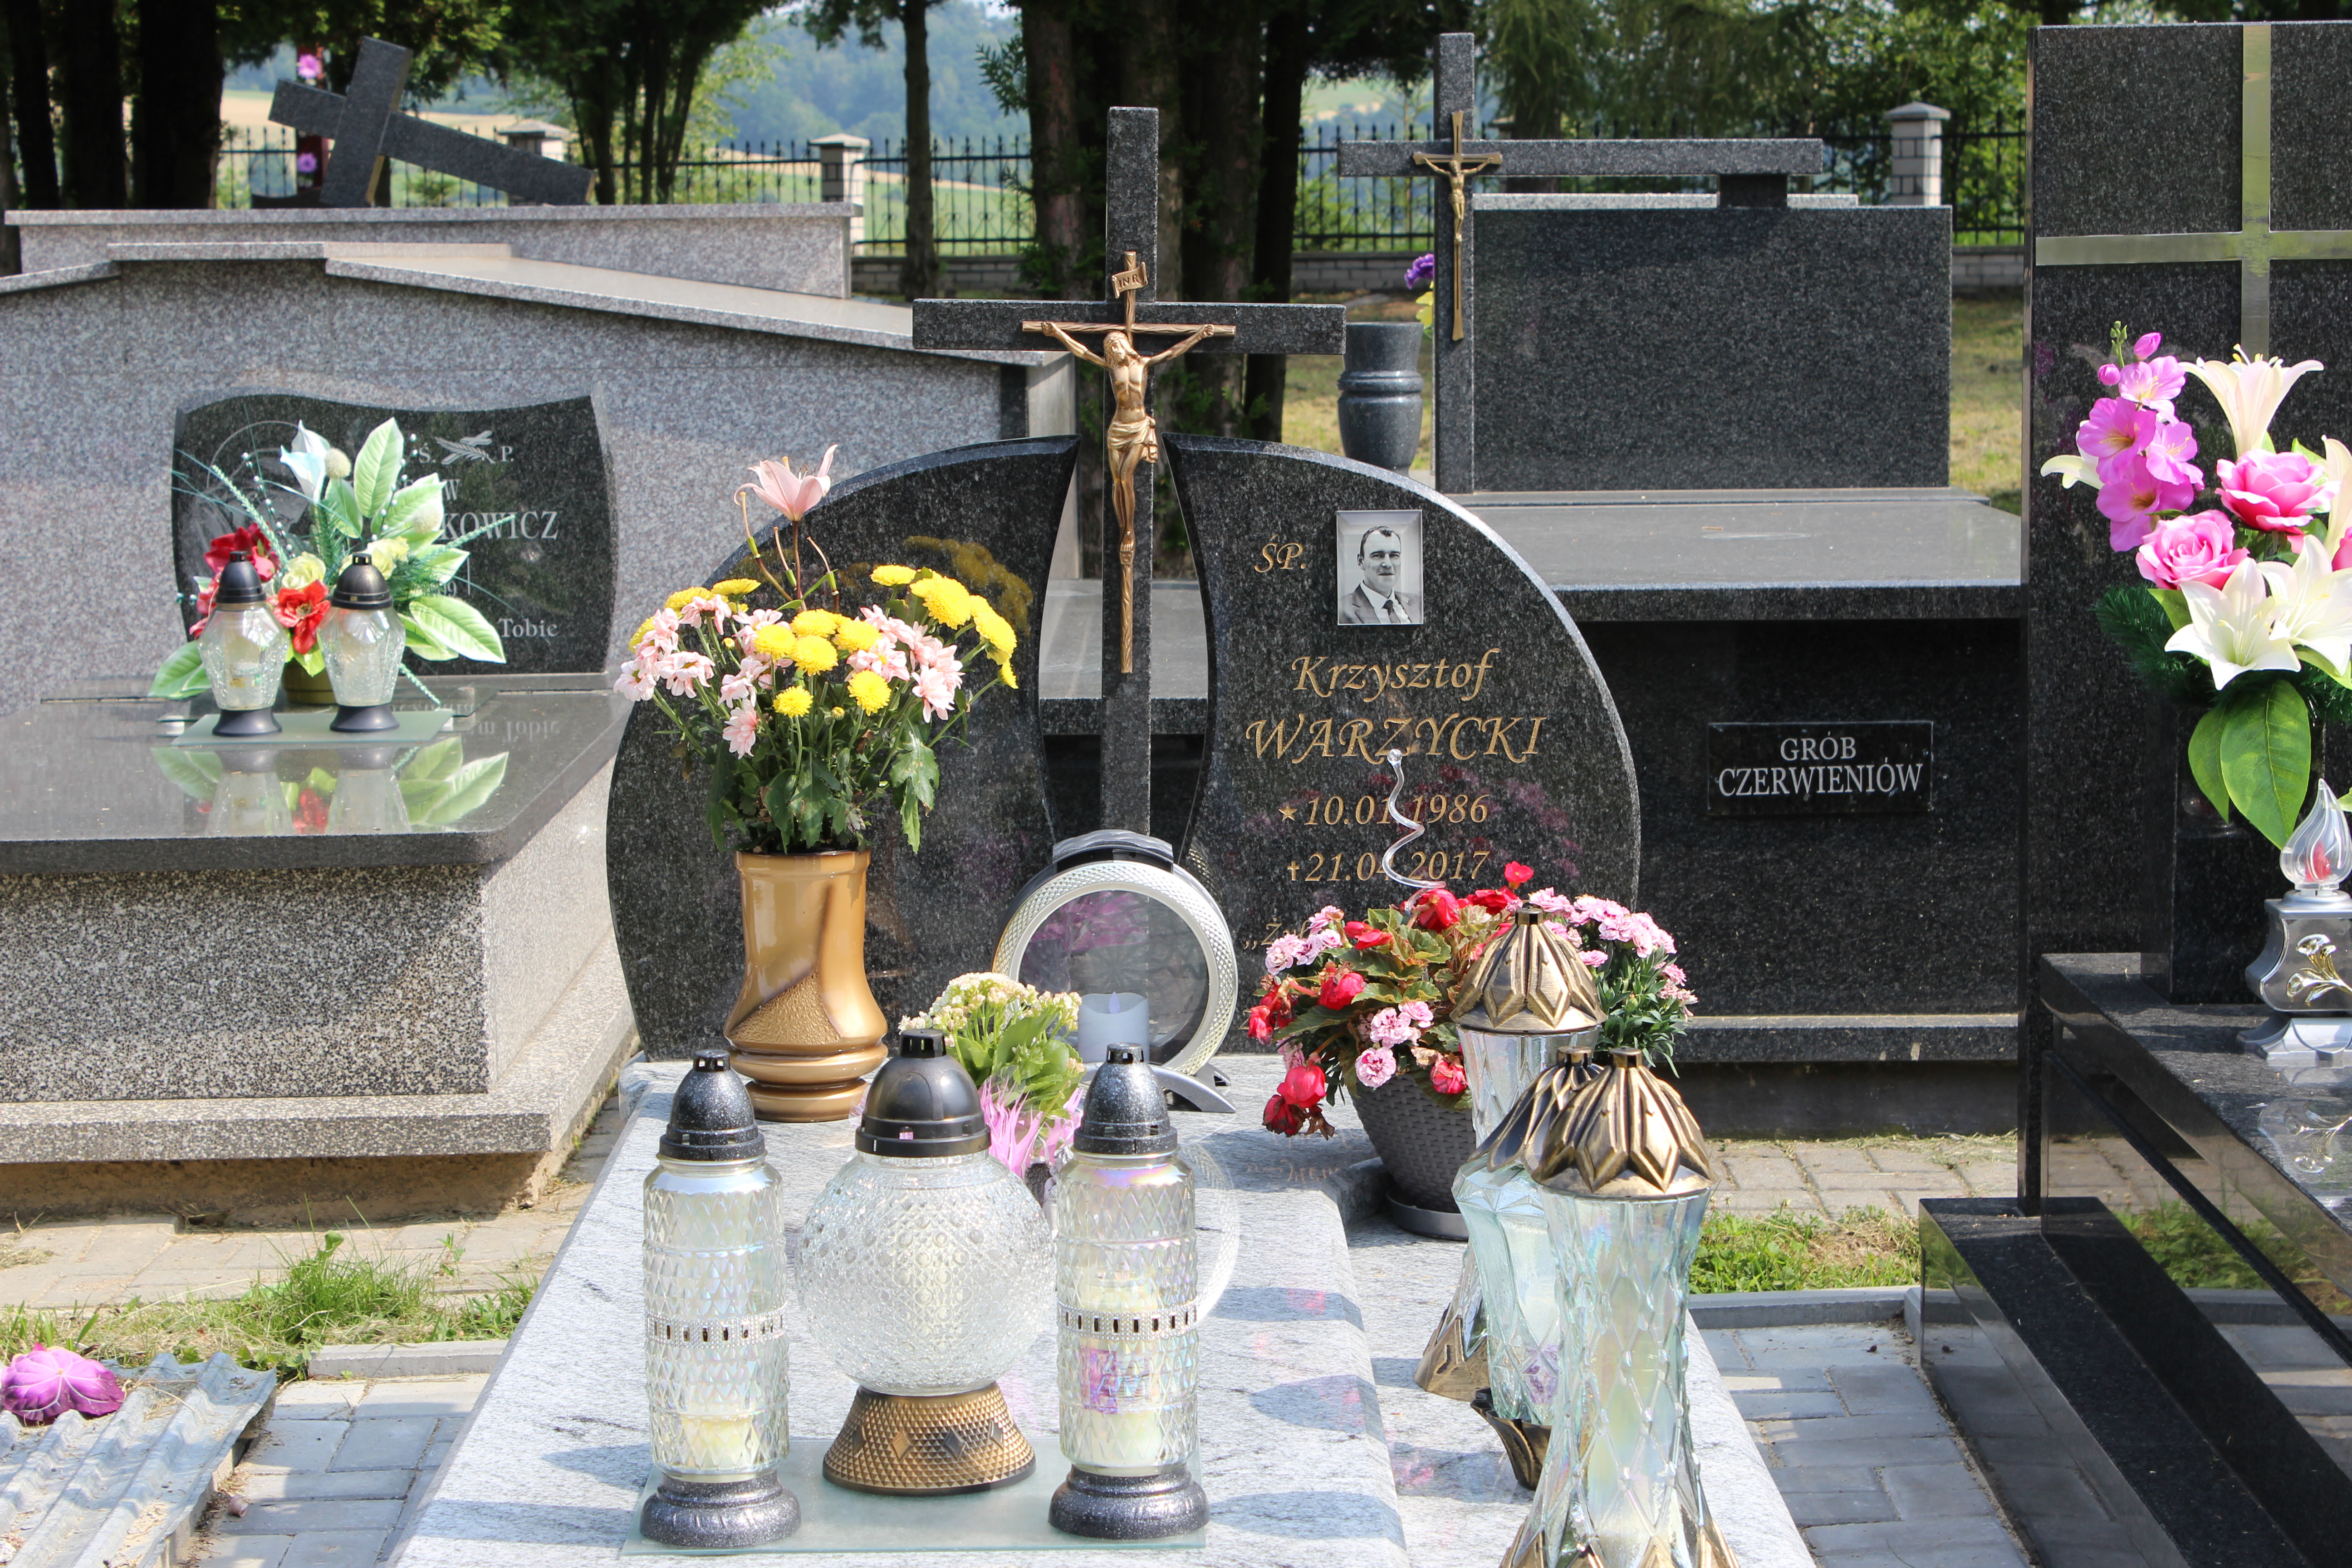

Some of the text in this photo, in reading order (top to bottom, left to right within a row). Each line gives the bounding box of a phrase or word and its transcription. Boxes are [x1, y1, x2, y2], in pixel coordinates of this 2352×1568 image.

[1118, 274, 1142, 289] INR
[440, 510, 559, 540] KOWICZ
[1292, 647, 1500, 703] Krzysztof
[1245, 712, 1547, 764] WARZYCKI
[1780, 731, 1857, 761] GRÓB
[1718, 757, 1923, 797] CZERWIENIÓW
[1304, 850, 1490, 882] 21.042017
